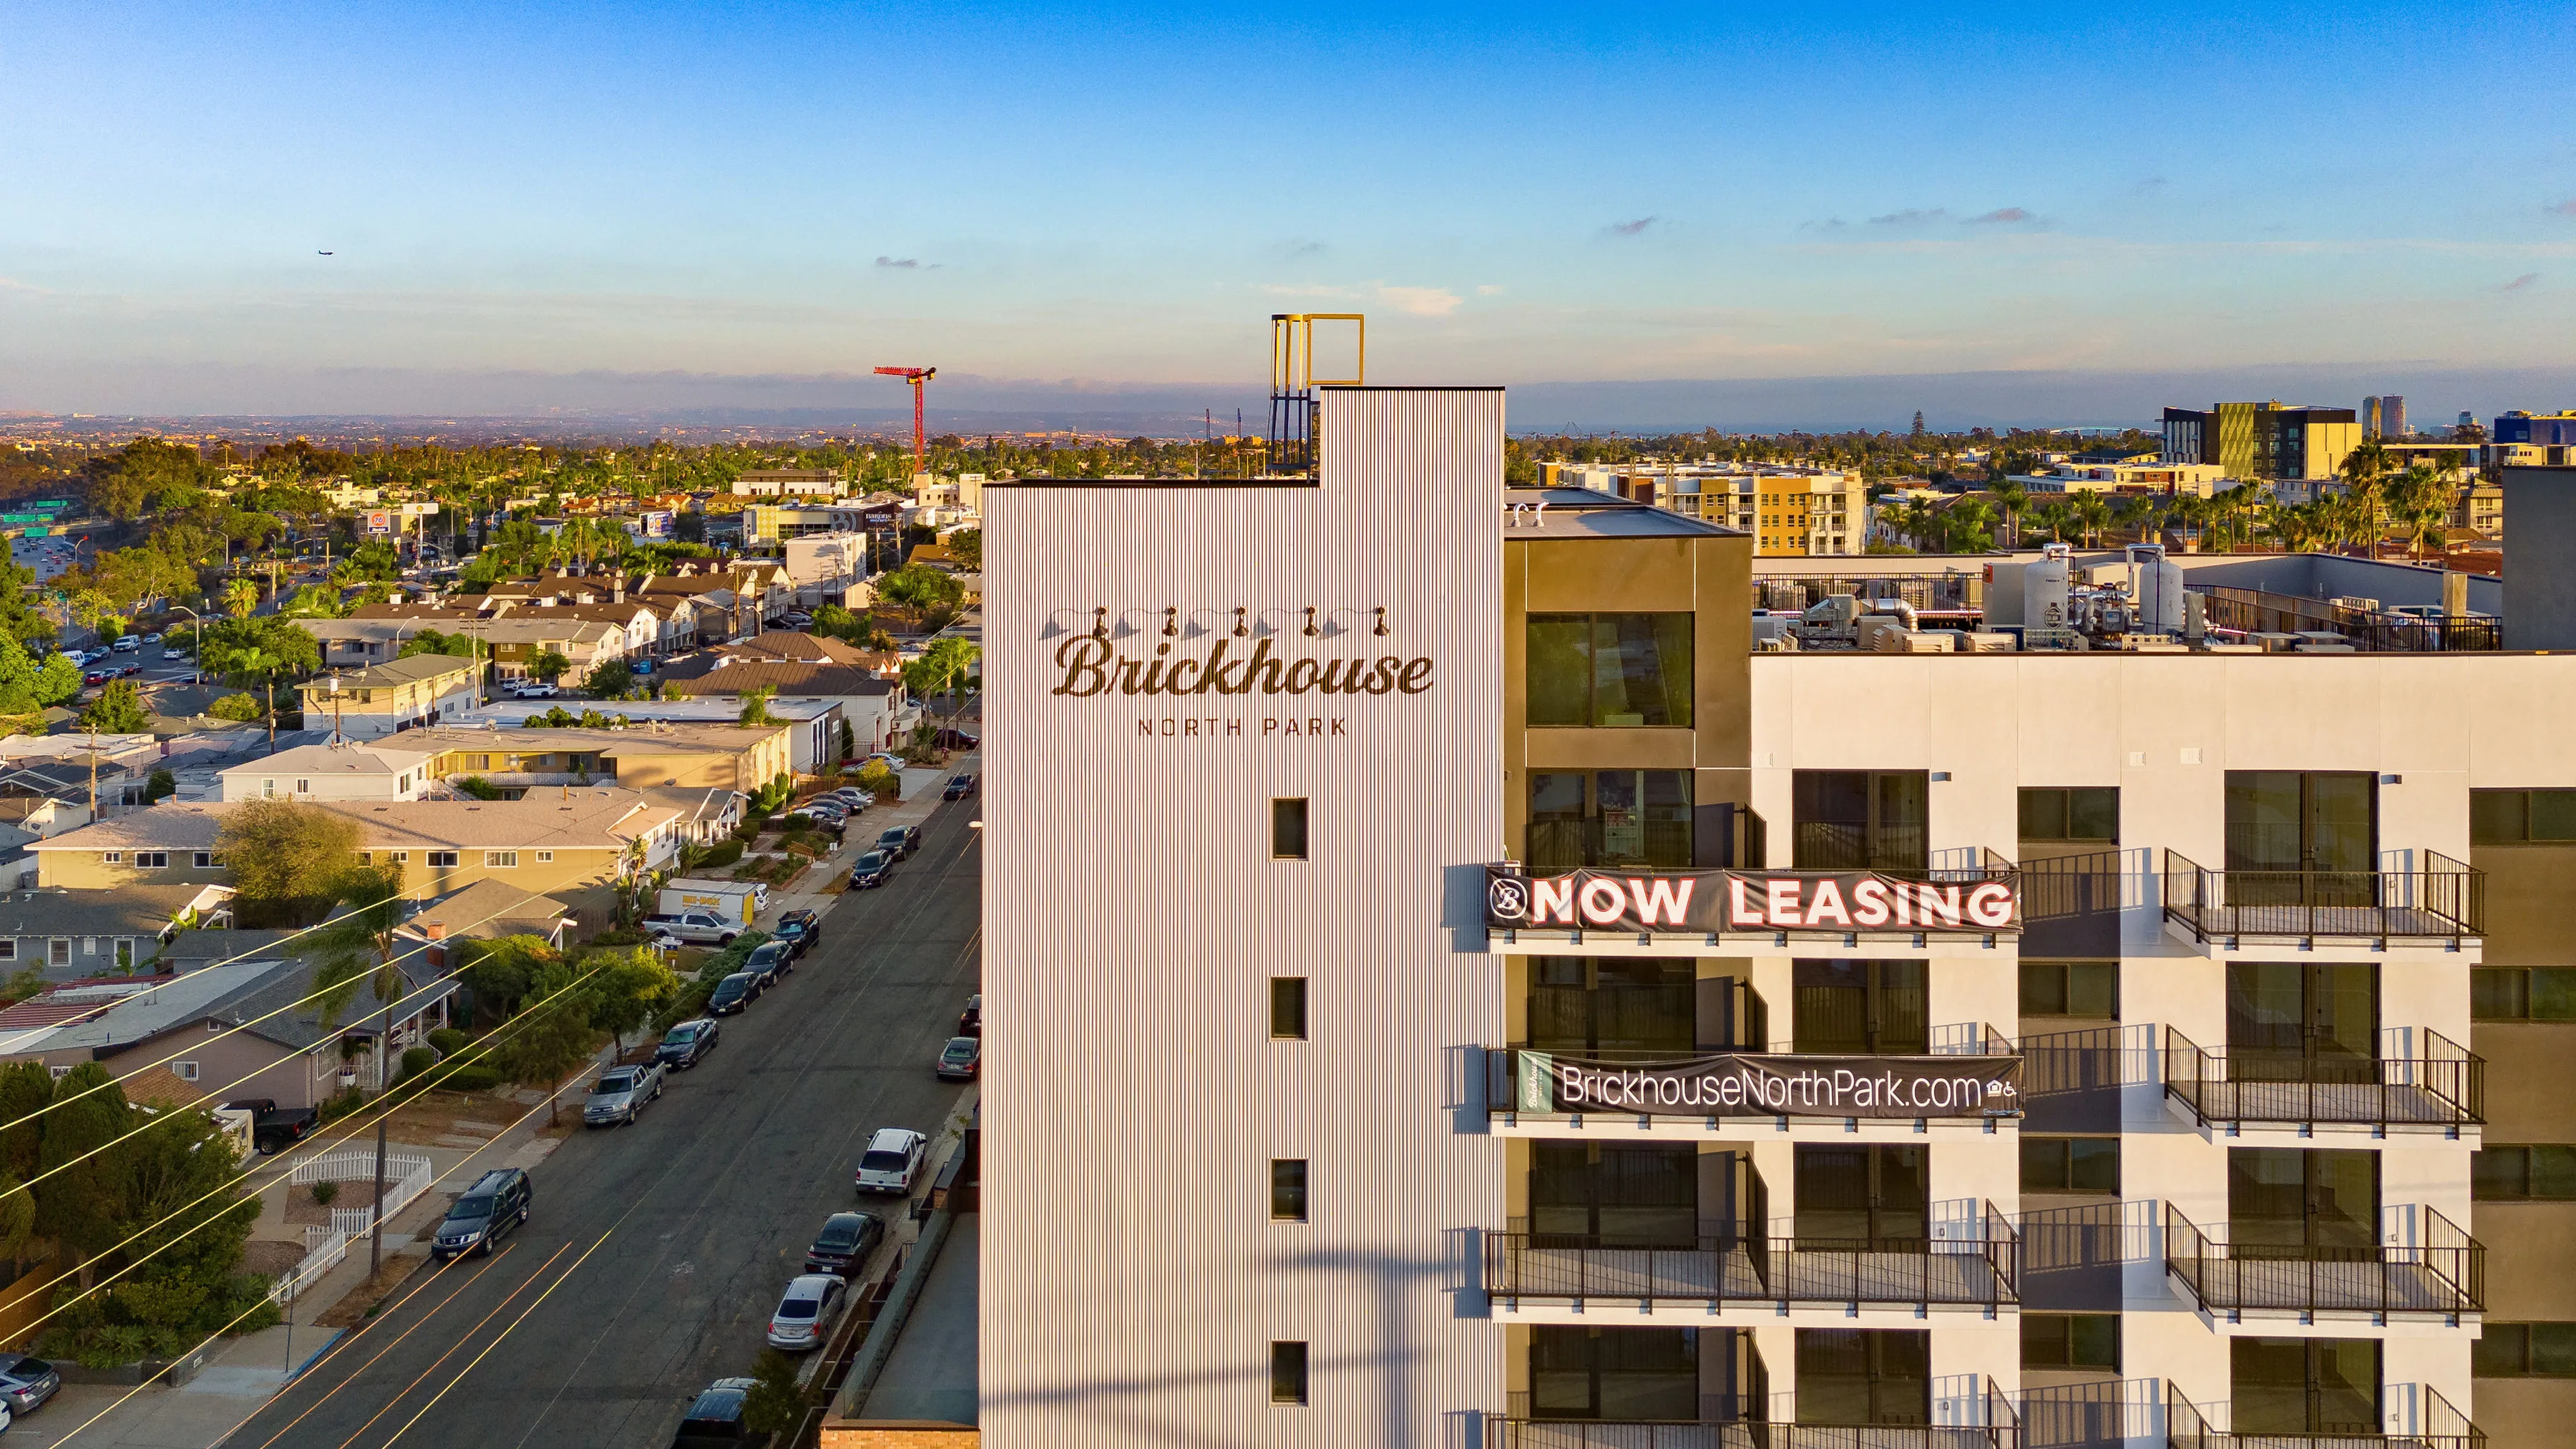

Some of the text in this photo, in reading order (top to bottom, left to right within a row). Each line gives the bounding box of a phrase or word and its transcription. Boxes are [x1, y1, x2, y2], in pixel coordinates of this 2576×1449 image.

[373, 516, 384, 525] 76
[1052, 634, 1433, 698] Brickhouse
[1138, 717, 1346, 736] NORTH PARK
[1532, 877, 2014, 927] NOW LEASING
[1563, 1066, 1981, 1108] BrickhouseNorthPark.com
